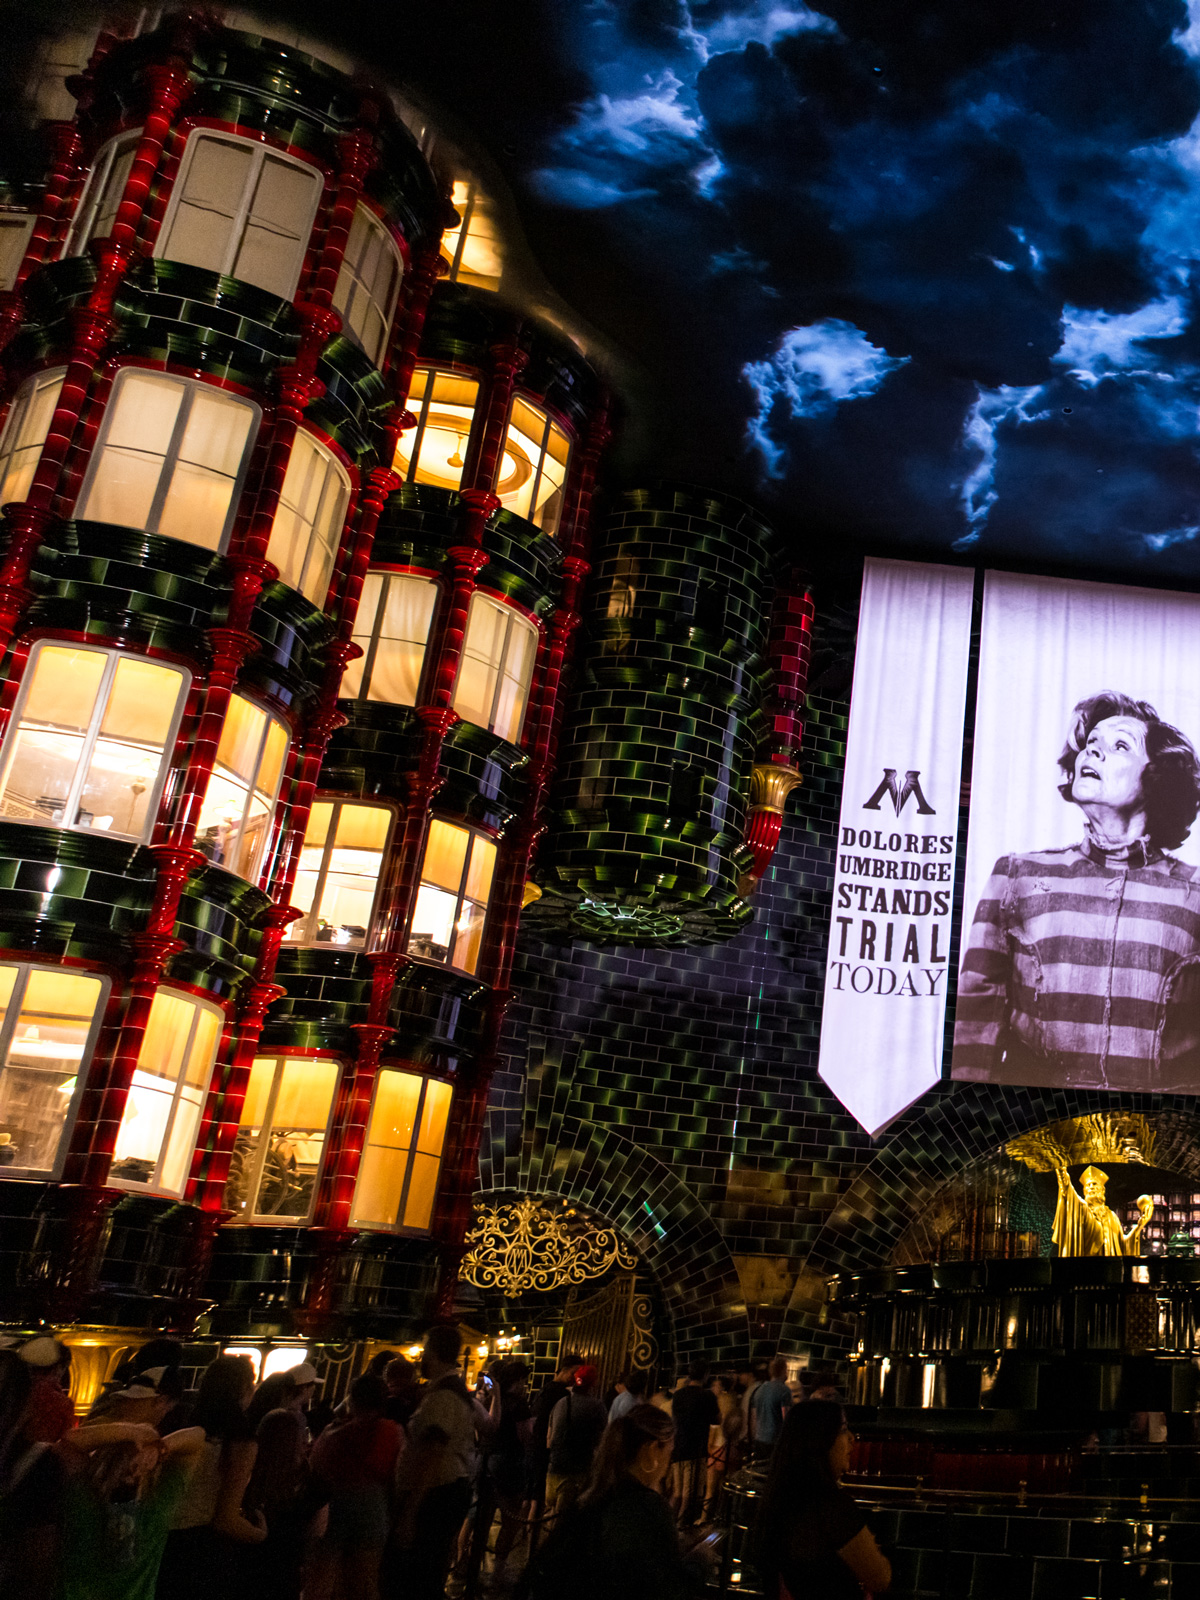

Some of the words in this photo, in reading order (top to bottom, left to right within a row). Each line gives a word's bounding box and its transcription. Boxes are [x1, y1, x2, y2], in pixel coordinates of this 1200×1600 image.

[841, 826, 954, 854] DOLORES
[839, 854, 951, 882] UMBRIDGE
[837, 882, 951, 916] STANDS
[836, 916, 946, 963] TRIAL
[830, 961, 947, 997] TODAY
